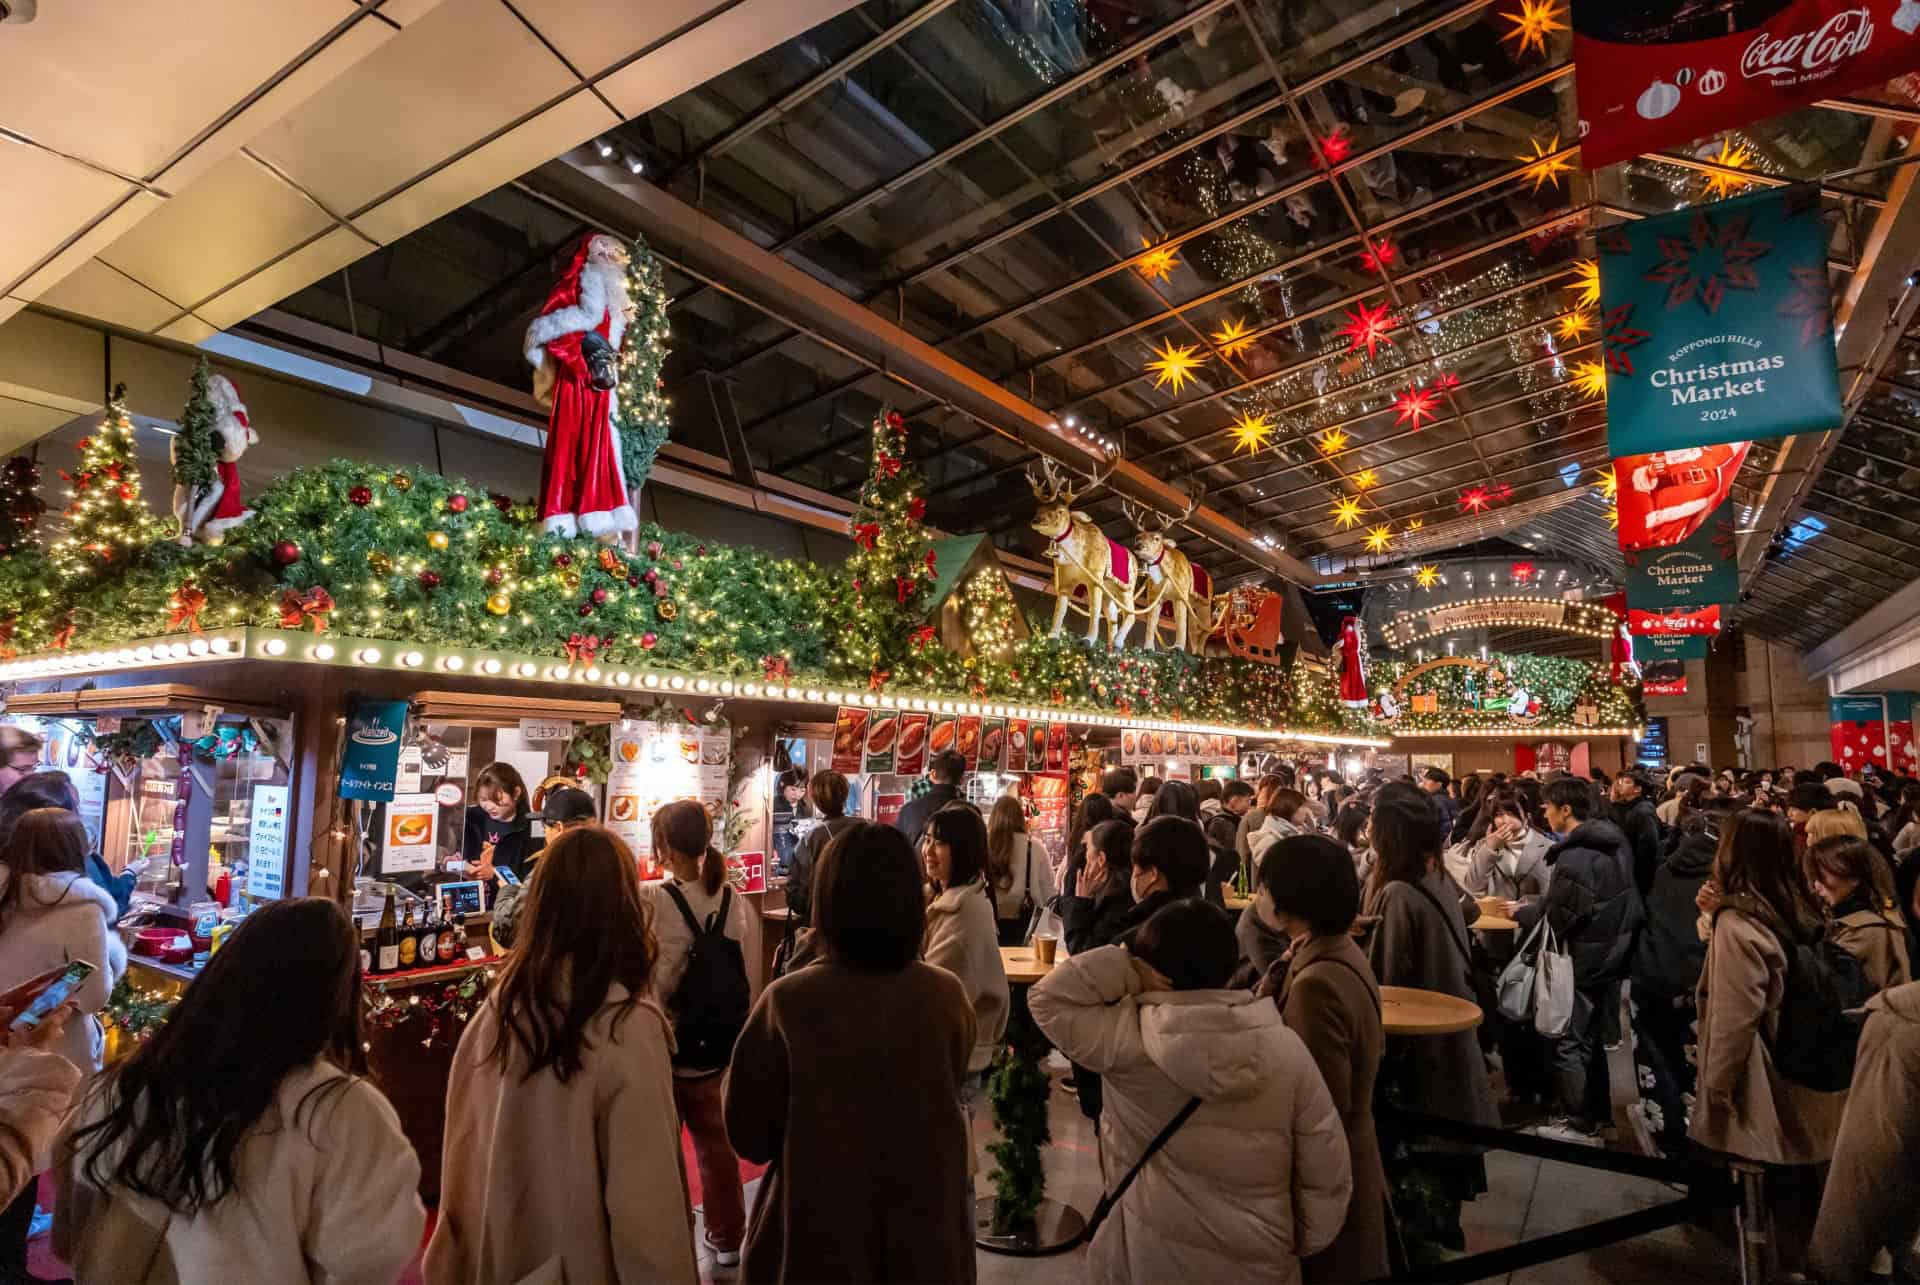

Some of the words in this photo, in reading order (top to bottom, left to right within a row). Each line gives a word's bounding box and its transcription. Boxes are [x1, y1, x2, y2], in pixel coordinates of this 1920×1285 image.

[1668, 336, 1726, 362] ROPPONGI
[1728, 335, 1763, 350] HILLS
[1650, 355, 1785, 388] Christmas
[1671, 377, 1767, 406] Market
[1700, 407, 1738, 422] 2024
[1647, 564, 1713, 576] Christmas
[1657, 574, 1705, 586] Market
[1444, 613, 1489, 625] Christmas
[1490, 611, 1524, 619] Market
